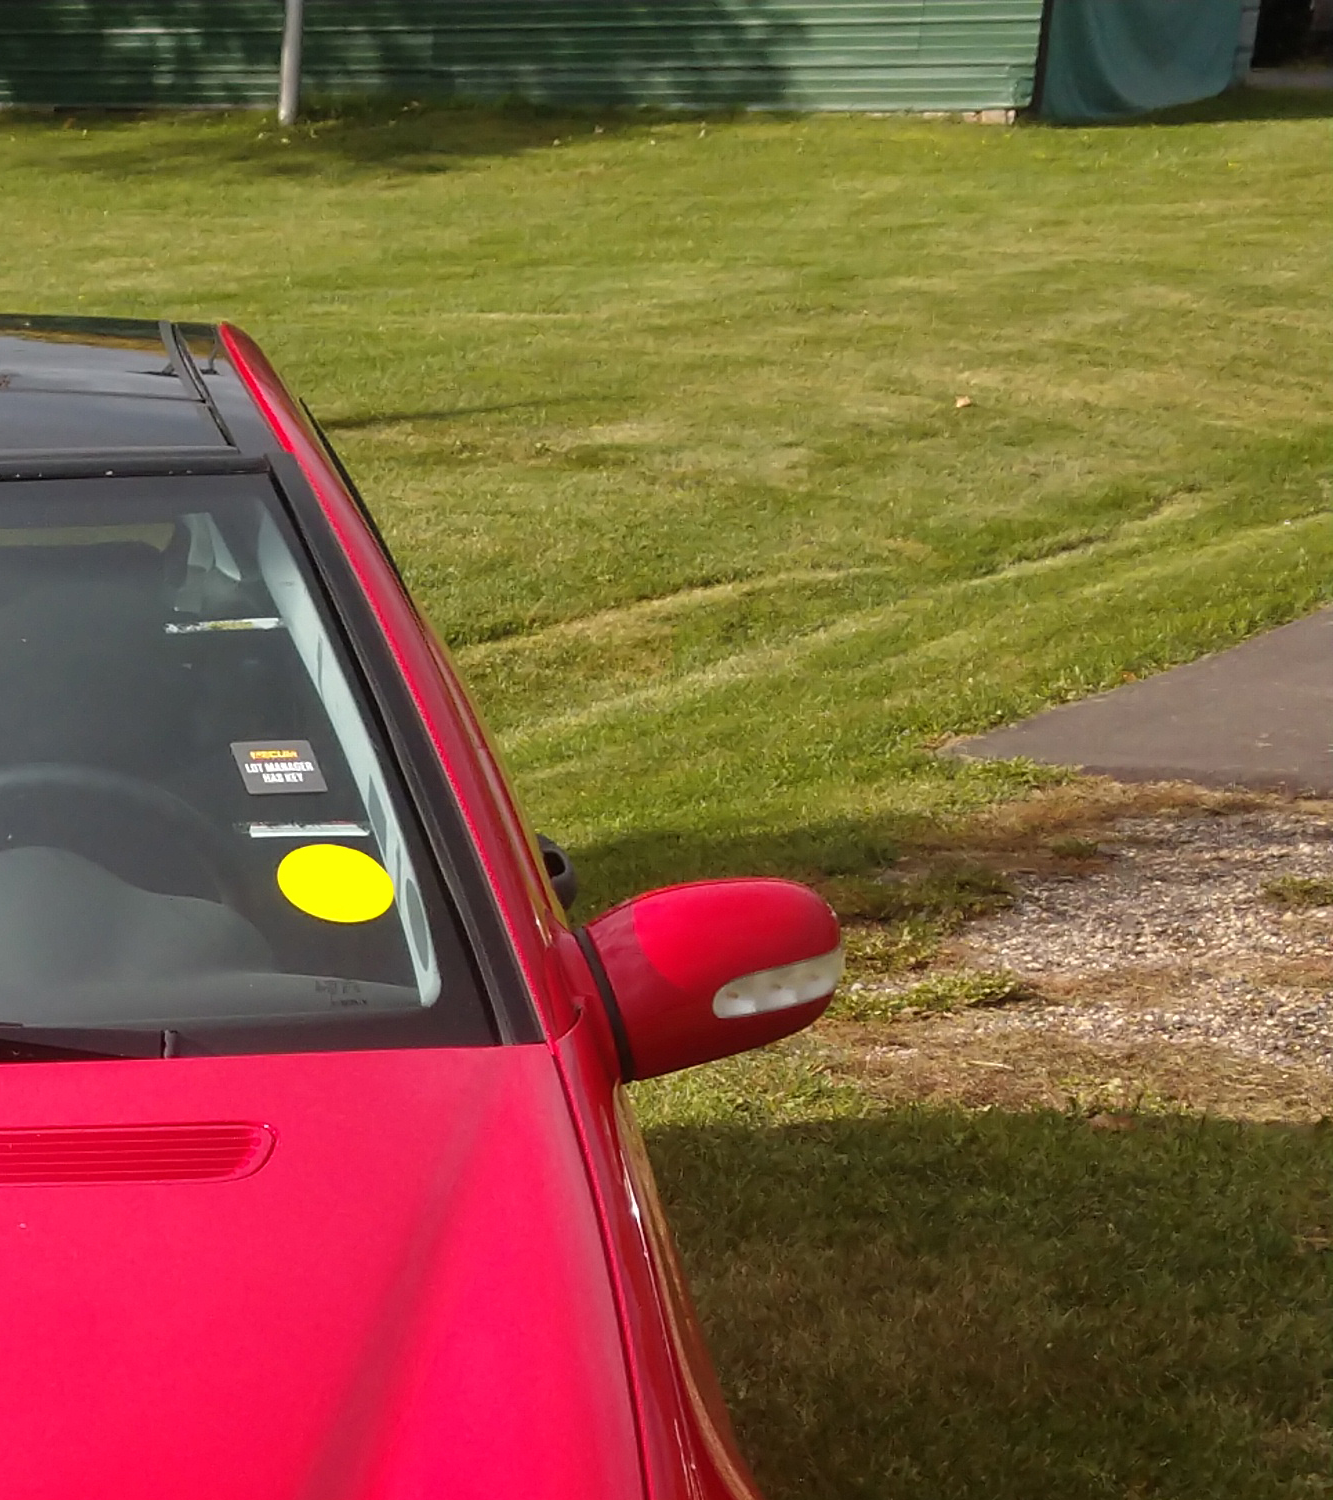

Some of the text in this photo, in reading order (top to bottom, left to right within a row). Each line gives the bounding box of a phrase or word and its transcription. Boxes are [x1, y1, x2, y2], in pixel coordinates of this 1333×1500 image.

[244, 761, 314, 773] LOT MANAGER
[262, 772, 304, 783] HAS KEY
